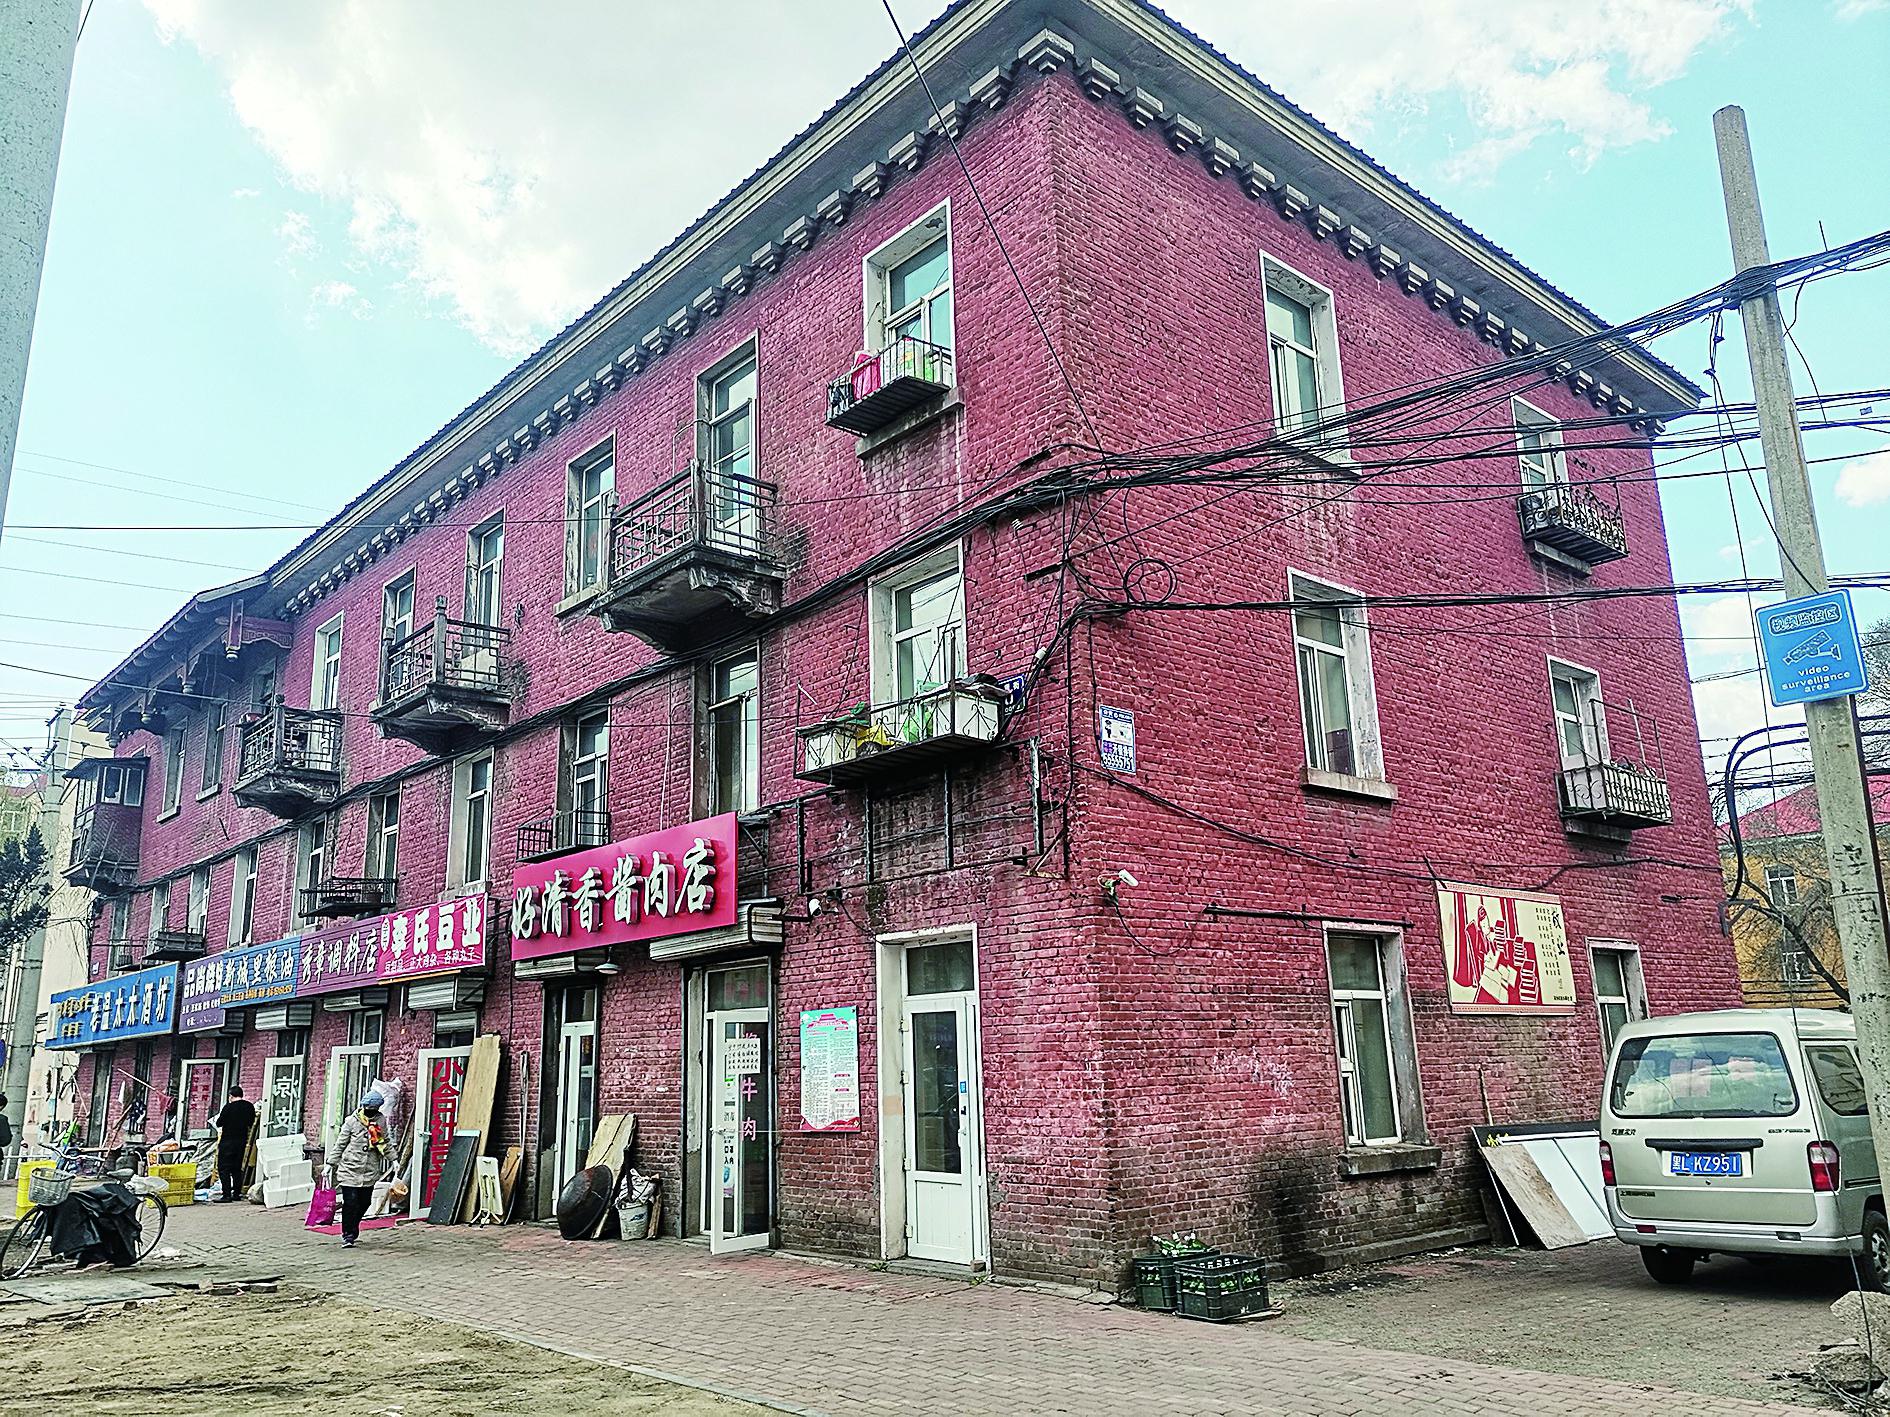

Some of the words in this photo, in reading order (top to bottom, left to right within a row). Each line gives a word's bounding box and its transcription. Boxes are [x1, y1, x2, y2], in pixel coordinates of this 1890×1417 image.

[1772, 608, 1838, 632] 视频监控区
[1781, 671, 1851, 691] surveillance
[1798, 665, 1830, 677] video
[1804, 682, 1831, 693] area
[511, 838, 715, 941] 好清香酱肉店
